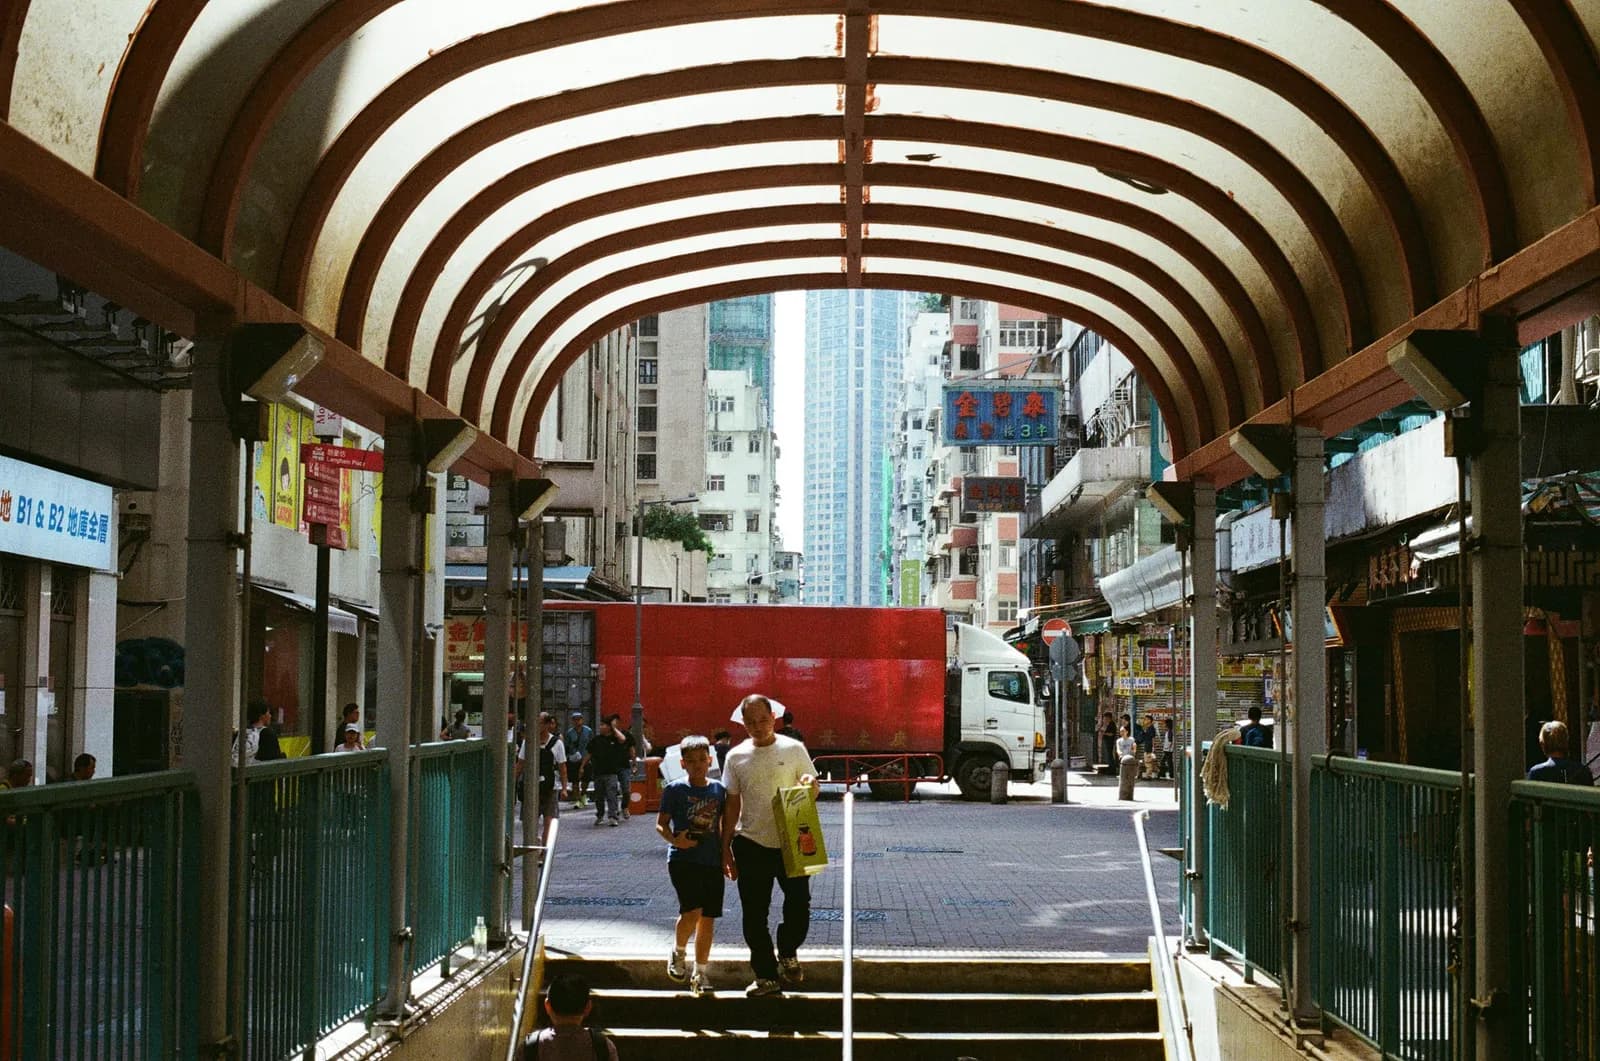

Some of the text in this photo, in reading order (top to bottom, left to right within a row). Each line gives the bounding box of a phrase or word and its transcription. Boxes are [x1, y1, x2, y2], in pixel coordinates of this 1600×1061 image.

[16, 495, 32, 526] B1
[35, 500, 44, 529] &
[48, 503, 65, 533] B2
[67, 505, 109, 544] 地庫全層
